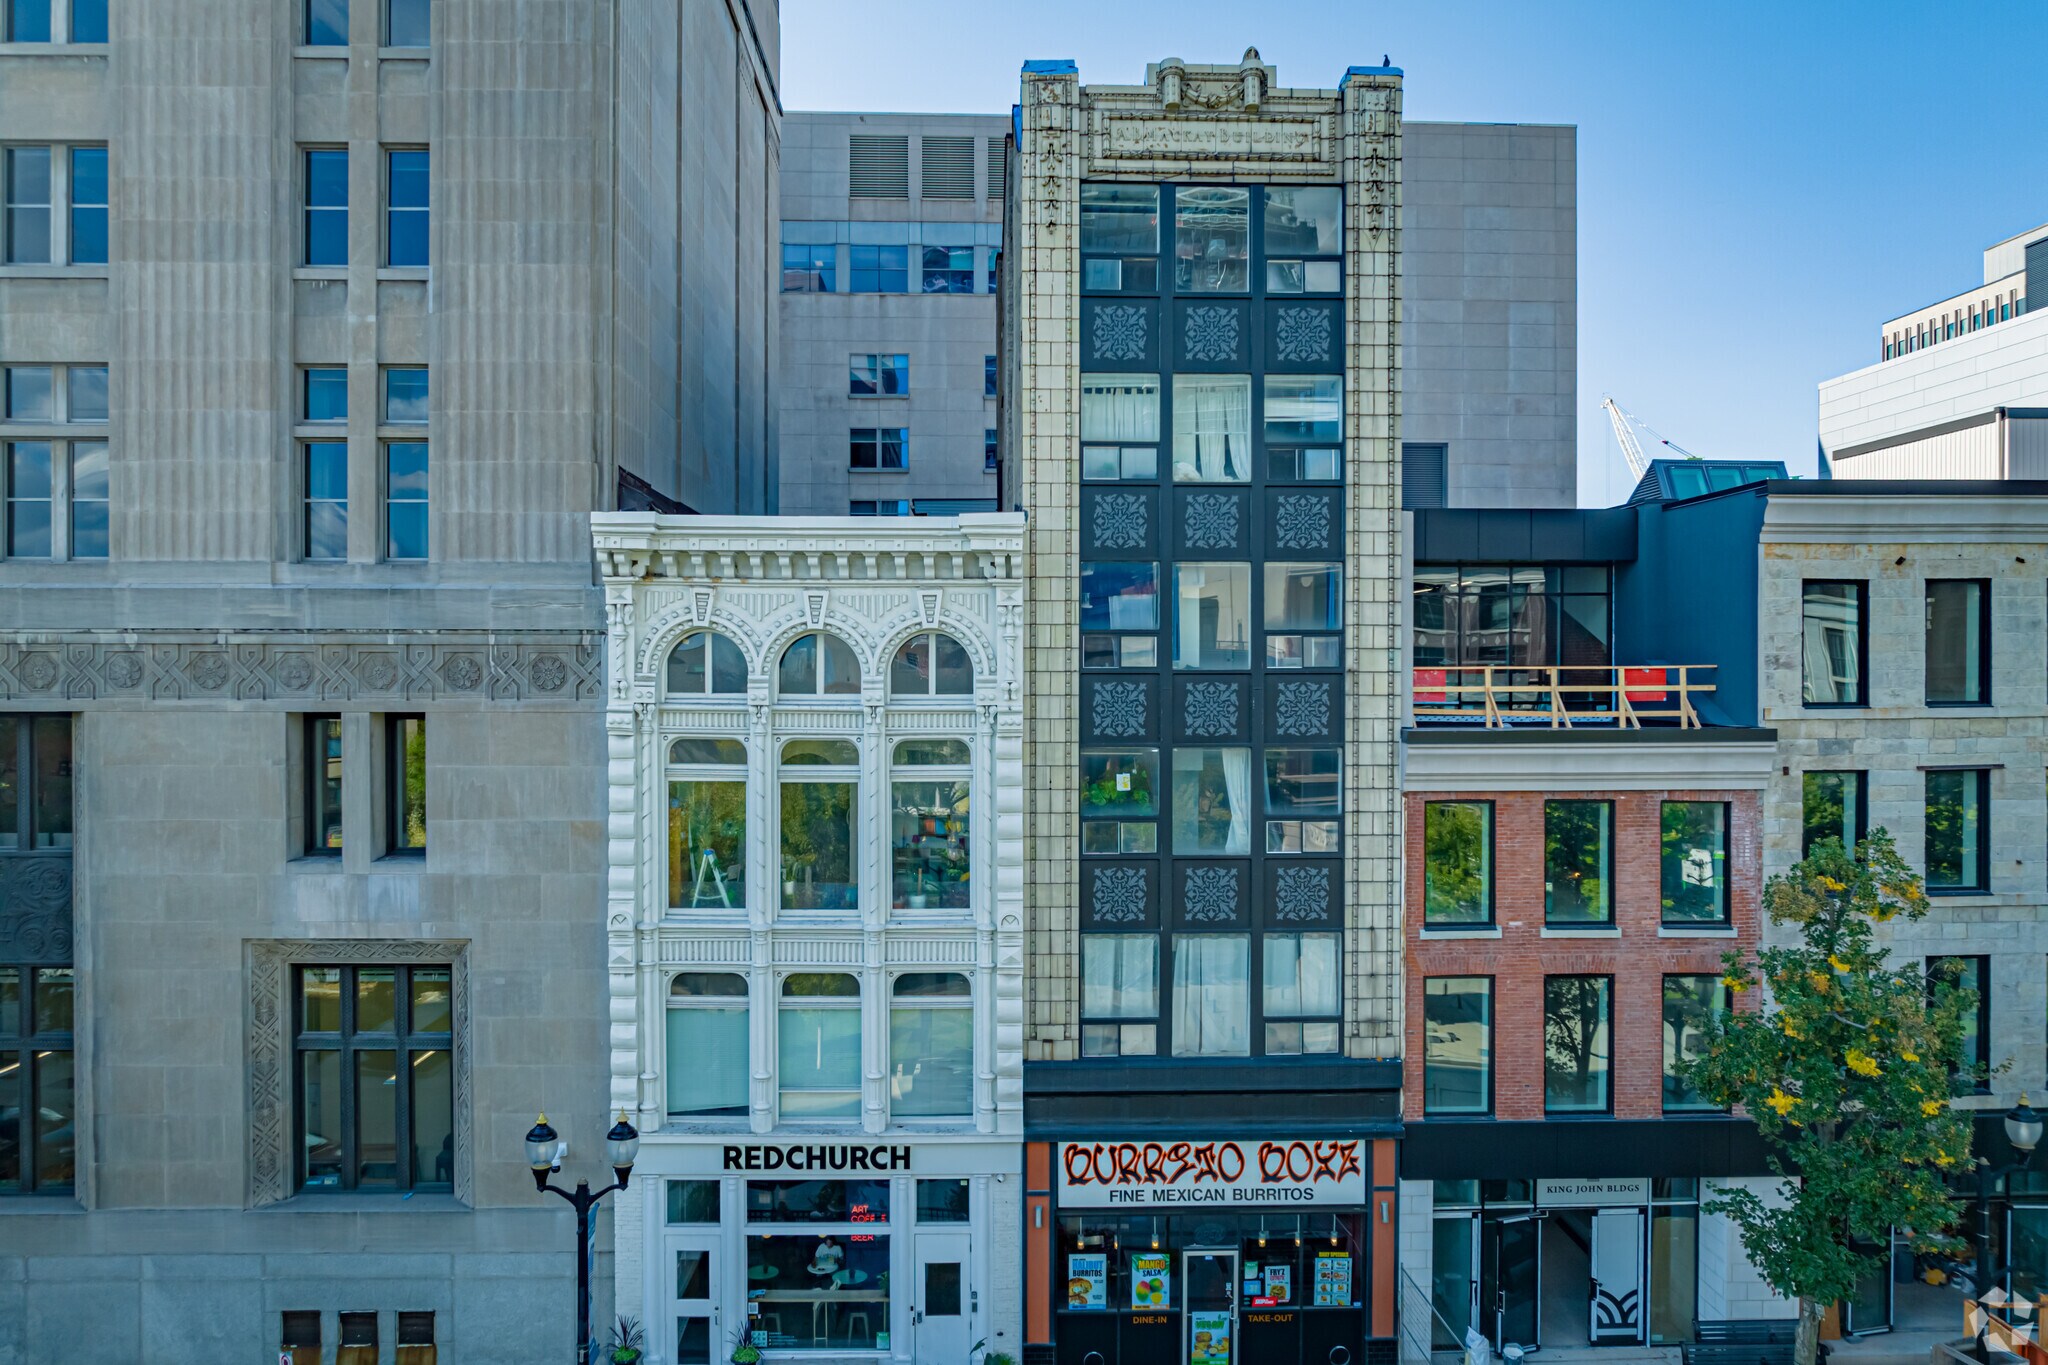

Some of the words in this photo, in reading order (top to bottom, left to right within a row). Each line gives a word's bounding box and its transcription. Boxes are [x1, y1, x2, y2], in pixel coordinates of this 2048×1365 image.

[1219, 128, 1310, 144] BUILDING
[723, 1145, 911, 1170] REDCHURCH
[1257, 1139, 1361, 1184] BOYZ
[1546, 1185, 1573, 1193] KING
[1576, 1185, 1603, 1194] JOHN
[1607, 1184, 1640, 1192] BLDGS
[1109, 1189, 1146, 1202] FINE
[1152, 1189, 1226, 1202] MEXICAN
[1232, 1187, 1314, 1201] BURRITOS
[851, 1204, 869, 1213] ART
[851, 1213, 887, 1223] COFFE
[1138, 1259, 1166, 1270] MANGO
[1072, 1269, 1103, 1277] BURRITOS
[1142, 1269, 1162, 1277] SALSA
[1132, 1315, 1168, 1324] DINE-IN
[1247, 1313, 1294, 1323] TAKE-OUT
